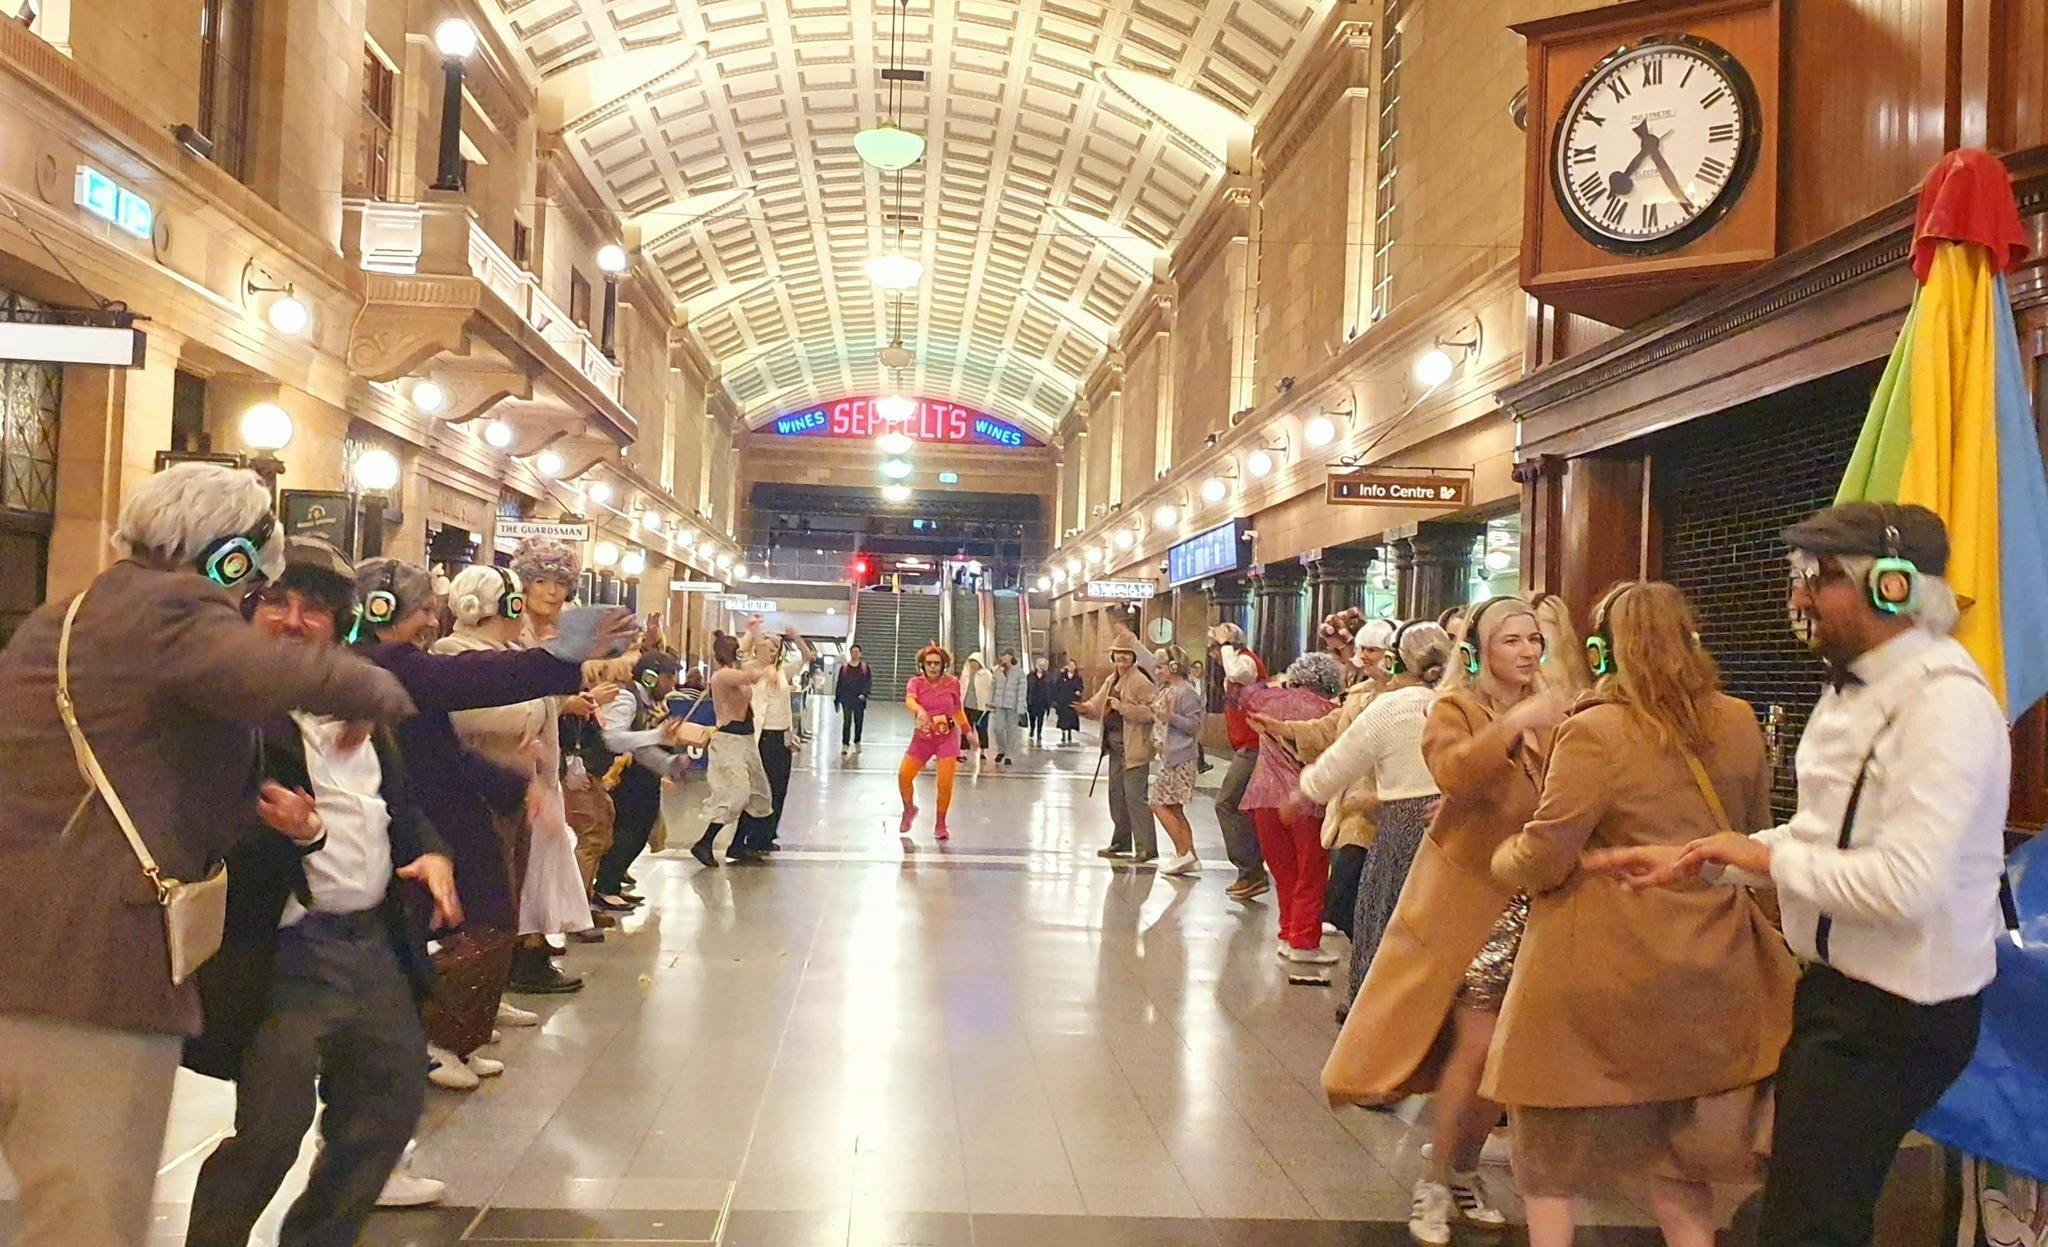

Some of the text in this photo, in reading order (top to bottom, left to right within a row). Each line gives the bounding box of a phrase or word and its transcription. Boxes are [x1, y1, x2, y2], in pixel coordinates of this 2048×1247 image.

[1642, 60, 1663, 88] XII
[1679, 64, 1695, 88] I
[1607, 75, 1631, 103] XI
[1700, 86, 1725, 109] II
[1583, 111, 1606, 128] X
[1709, 123, 1733, 143] III
[1574, 144, 1597, 164] IX
[1695, 156, 1725, 185] IIII
[1578, 171, 1607, 206] VIII
[1602, 196, 1628, 225] VII
[1642, 203, 1658, 229] VI
[778, 411, 825, 434] WINES
[976, 420, 1022, 445] WINES
[1359, 483, 1386, 497] Info
[1389, 484, 1435, 499] Centre
[500, 524, 584, 537] THE GUARDSMAN
